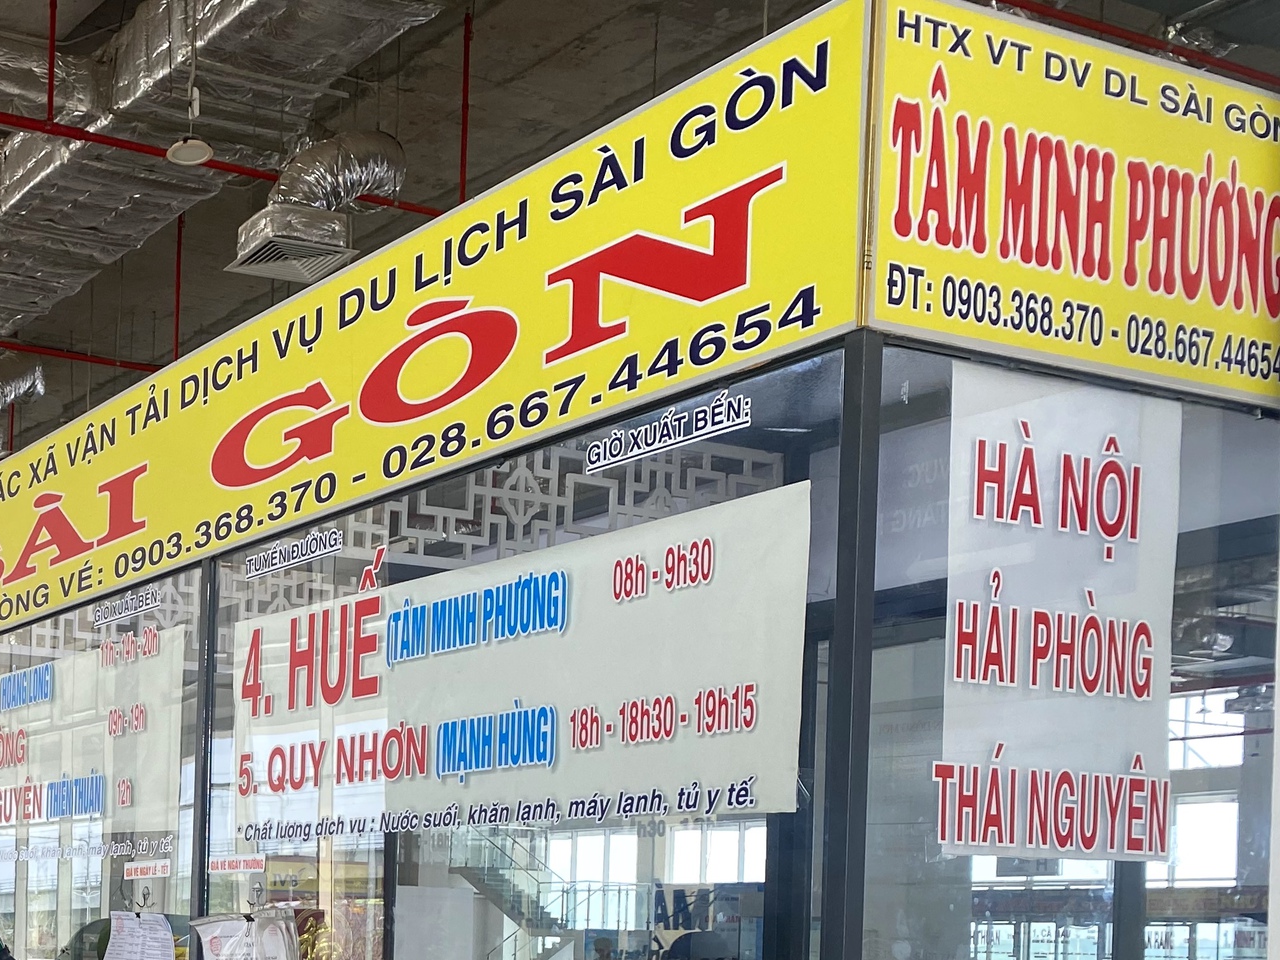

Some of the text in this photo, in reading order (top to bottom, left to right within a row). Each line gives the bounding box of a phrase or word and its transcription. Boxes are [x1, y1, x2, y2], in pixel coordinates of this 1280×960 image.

[898, 10, 973, 58] HTX
[986, 35, 1032, 72] VT
[1044, 52, 1091, 88] DV
[1104, 68, 1148, 105] DL
[1159, 84, 1213, 124] SÀI
[892, 64, 1280, 320] TÂM MINH PHƯƠNG
[28, 445, 59, 489] XÃ
[66, 418, 117, 468] VẬN
[126, 385, 170, 436] TẢI
[180, 340, 258, 411] DỊCH
[272, 306, 323, 360] VỤ
[339, 267, 397, 330] DU
[414, 198, 528, 292] LỊCH
[549, 136, 646, 222] SÀI
[670, 39, 829, 159] GÒN
[887, 263, 933, 312] ĐT:
[942, 276, 1103, 347] 0903.368.370
[211, 165, 784, 489] GÒN
[59, 562, 104, 599] VÉ:
[114, 472, 338, 579] 0903.368.370
[382, 284, 821, 479] 028.667.44654
[587, 391, 751, 465] GIỜ XUẤT BẾN:
[974, 419, 1142, 563] HÀ NỘI
[246, 528, 344, 576] TUYẾN ĐƯỜNG:
[613, 537, 714, 600] 08h 9h30
[94, 600, 111, 623] GIỜ
[111, 590, 136, 617] XUẤT
[142, 625, 159, 657] 20h
[241, 546, 570, 718] 4. HUẾ (TÂM MINH PHƯƠNG)
[953, 567, 1155, 701] HẢI PHÒNG
[108, 702, 147, 737] 09h 19h
[238, 698, 557, 797] 5. QUY NHƠN (MẠNH HÙNG)
[570, 683, 757, 749] 18h 18h30 19h15
[116, 777, 132, 807] 12h
[244, 775, 756, 844] Chất lượng dịch vụ Nước suối, khăn lạnh, máy lạnh, tủ y tế.
[932, 742, 1170, 854] THÁI NGUYÊN
